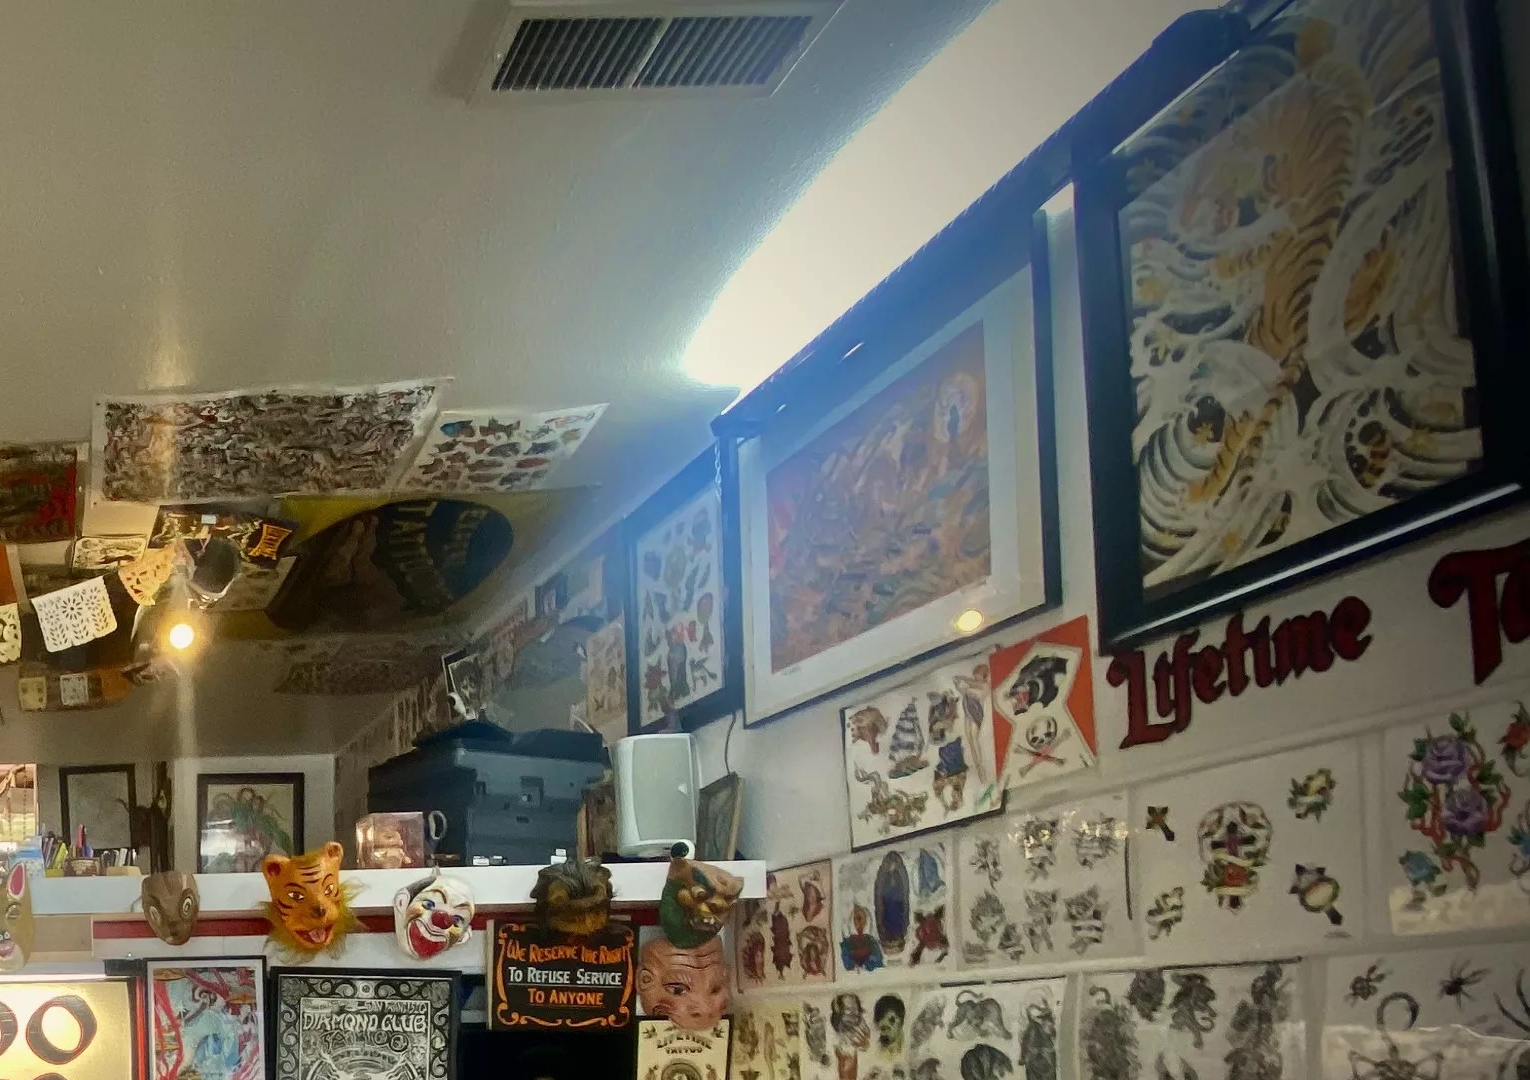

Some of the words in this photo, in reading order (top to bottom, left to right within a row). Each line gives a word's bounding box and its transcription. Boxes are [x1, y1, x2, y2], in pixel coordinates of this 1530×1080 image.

[1106, 596, 1373, 749] Lifetime
[529, 943, 577, 963] RESERVE
[303, 1013, 378, 1032] DIAMOND
[381, 1014, 427, 1033] CLUB
